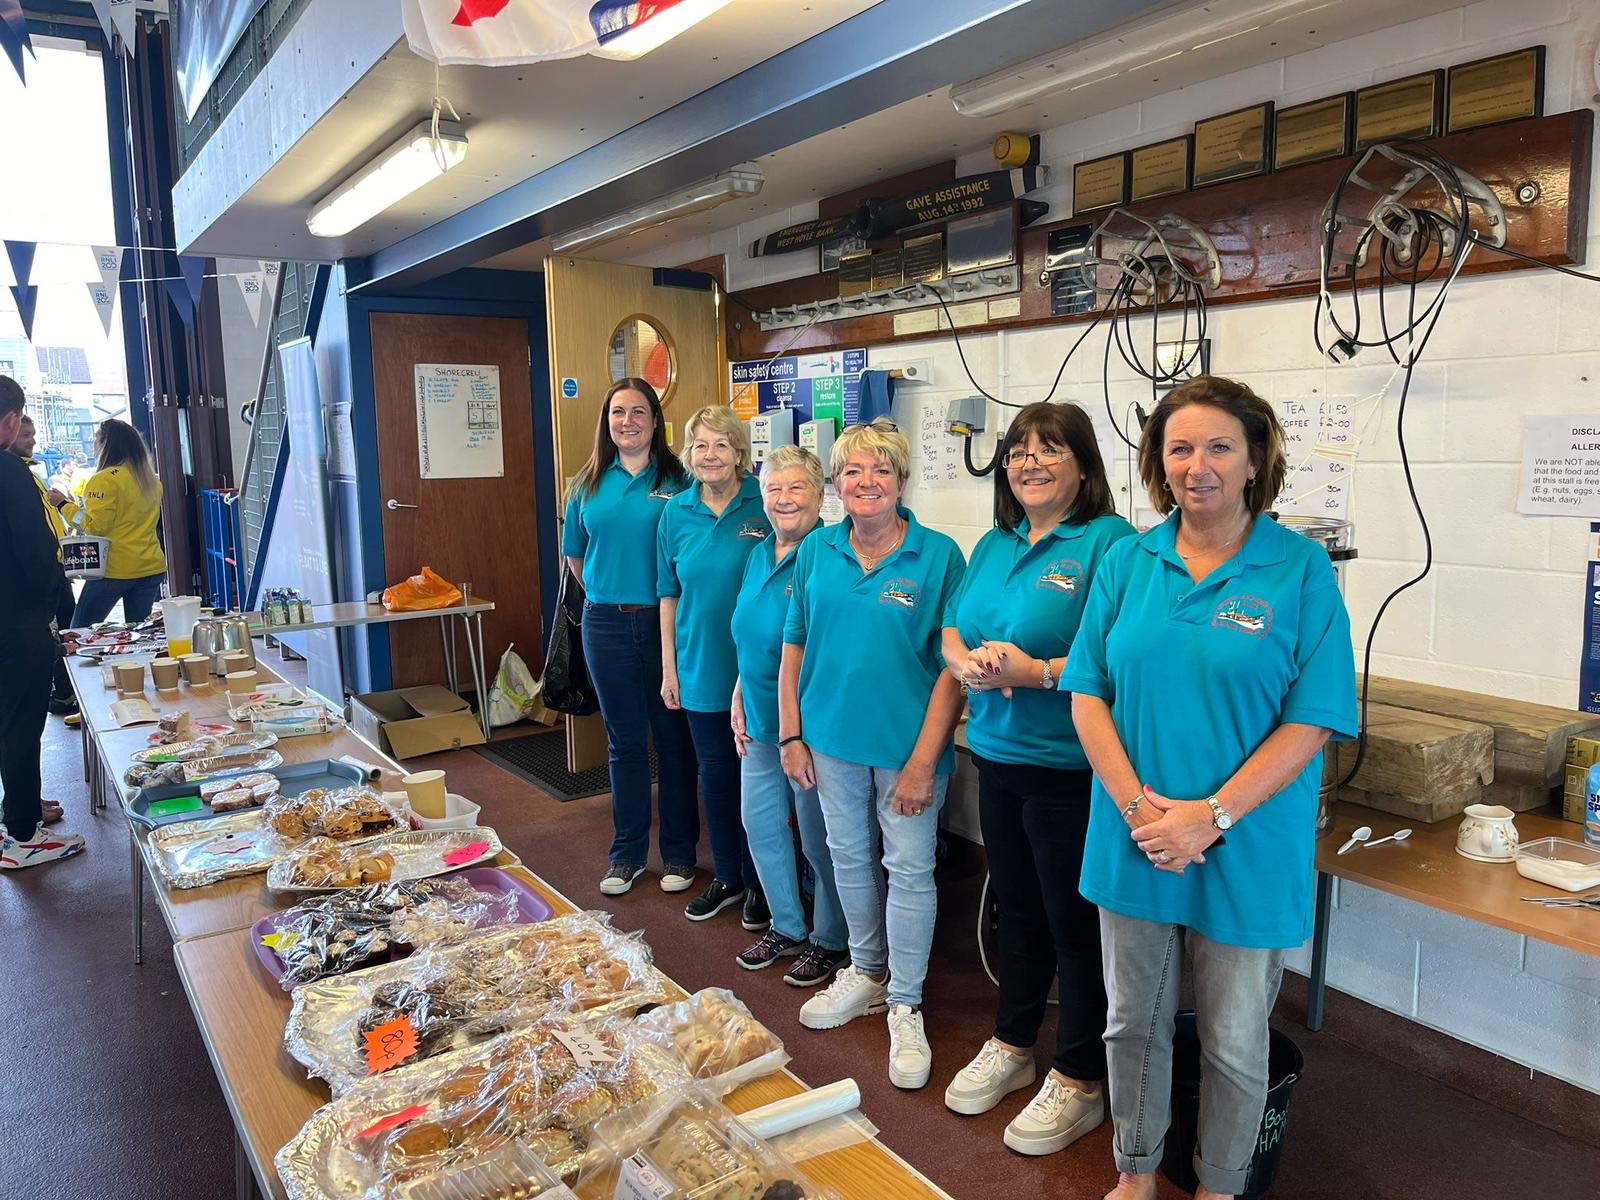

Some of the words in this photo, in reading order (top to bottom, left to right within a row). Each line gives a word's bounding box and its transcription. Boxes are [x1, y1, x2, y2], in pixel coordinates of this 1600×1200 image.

[906, 194, 932, 210] GAVE
[935, 180, 990, 203] ASSISTANCE
[917, 208, 943, 221] AUG.
[961, 197, 985, 211] 1992
[777, 237, 795, 248] WEST
[734, 367, 748, 379] skin
[748, 363, 769, 379] safety
[770, 362, 794, 376] centre
[773, 383, 789, 395] STEP
[790, 383, 796, 393] 2
[815, 378, 833, 391] STEP
[835, 377, 841, 389] 3
[734, 385, 750, 396] STEP
[776, 394, 792, 402] cleanse
[922, 406, 934, 417] TEA
[1283, 401, 1306, 414] TEA
[922, 420, 942, 431] COFFEE
[1535, 458, 1548, 466] We
[1584, 468, 1599, 476] and
[1552, 487, 1571, 495] nuts,
[1573, 488, 1595, 496] eggs,
[1531, 495, 1557, 503] wheat,
